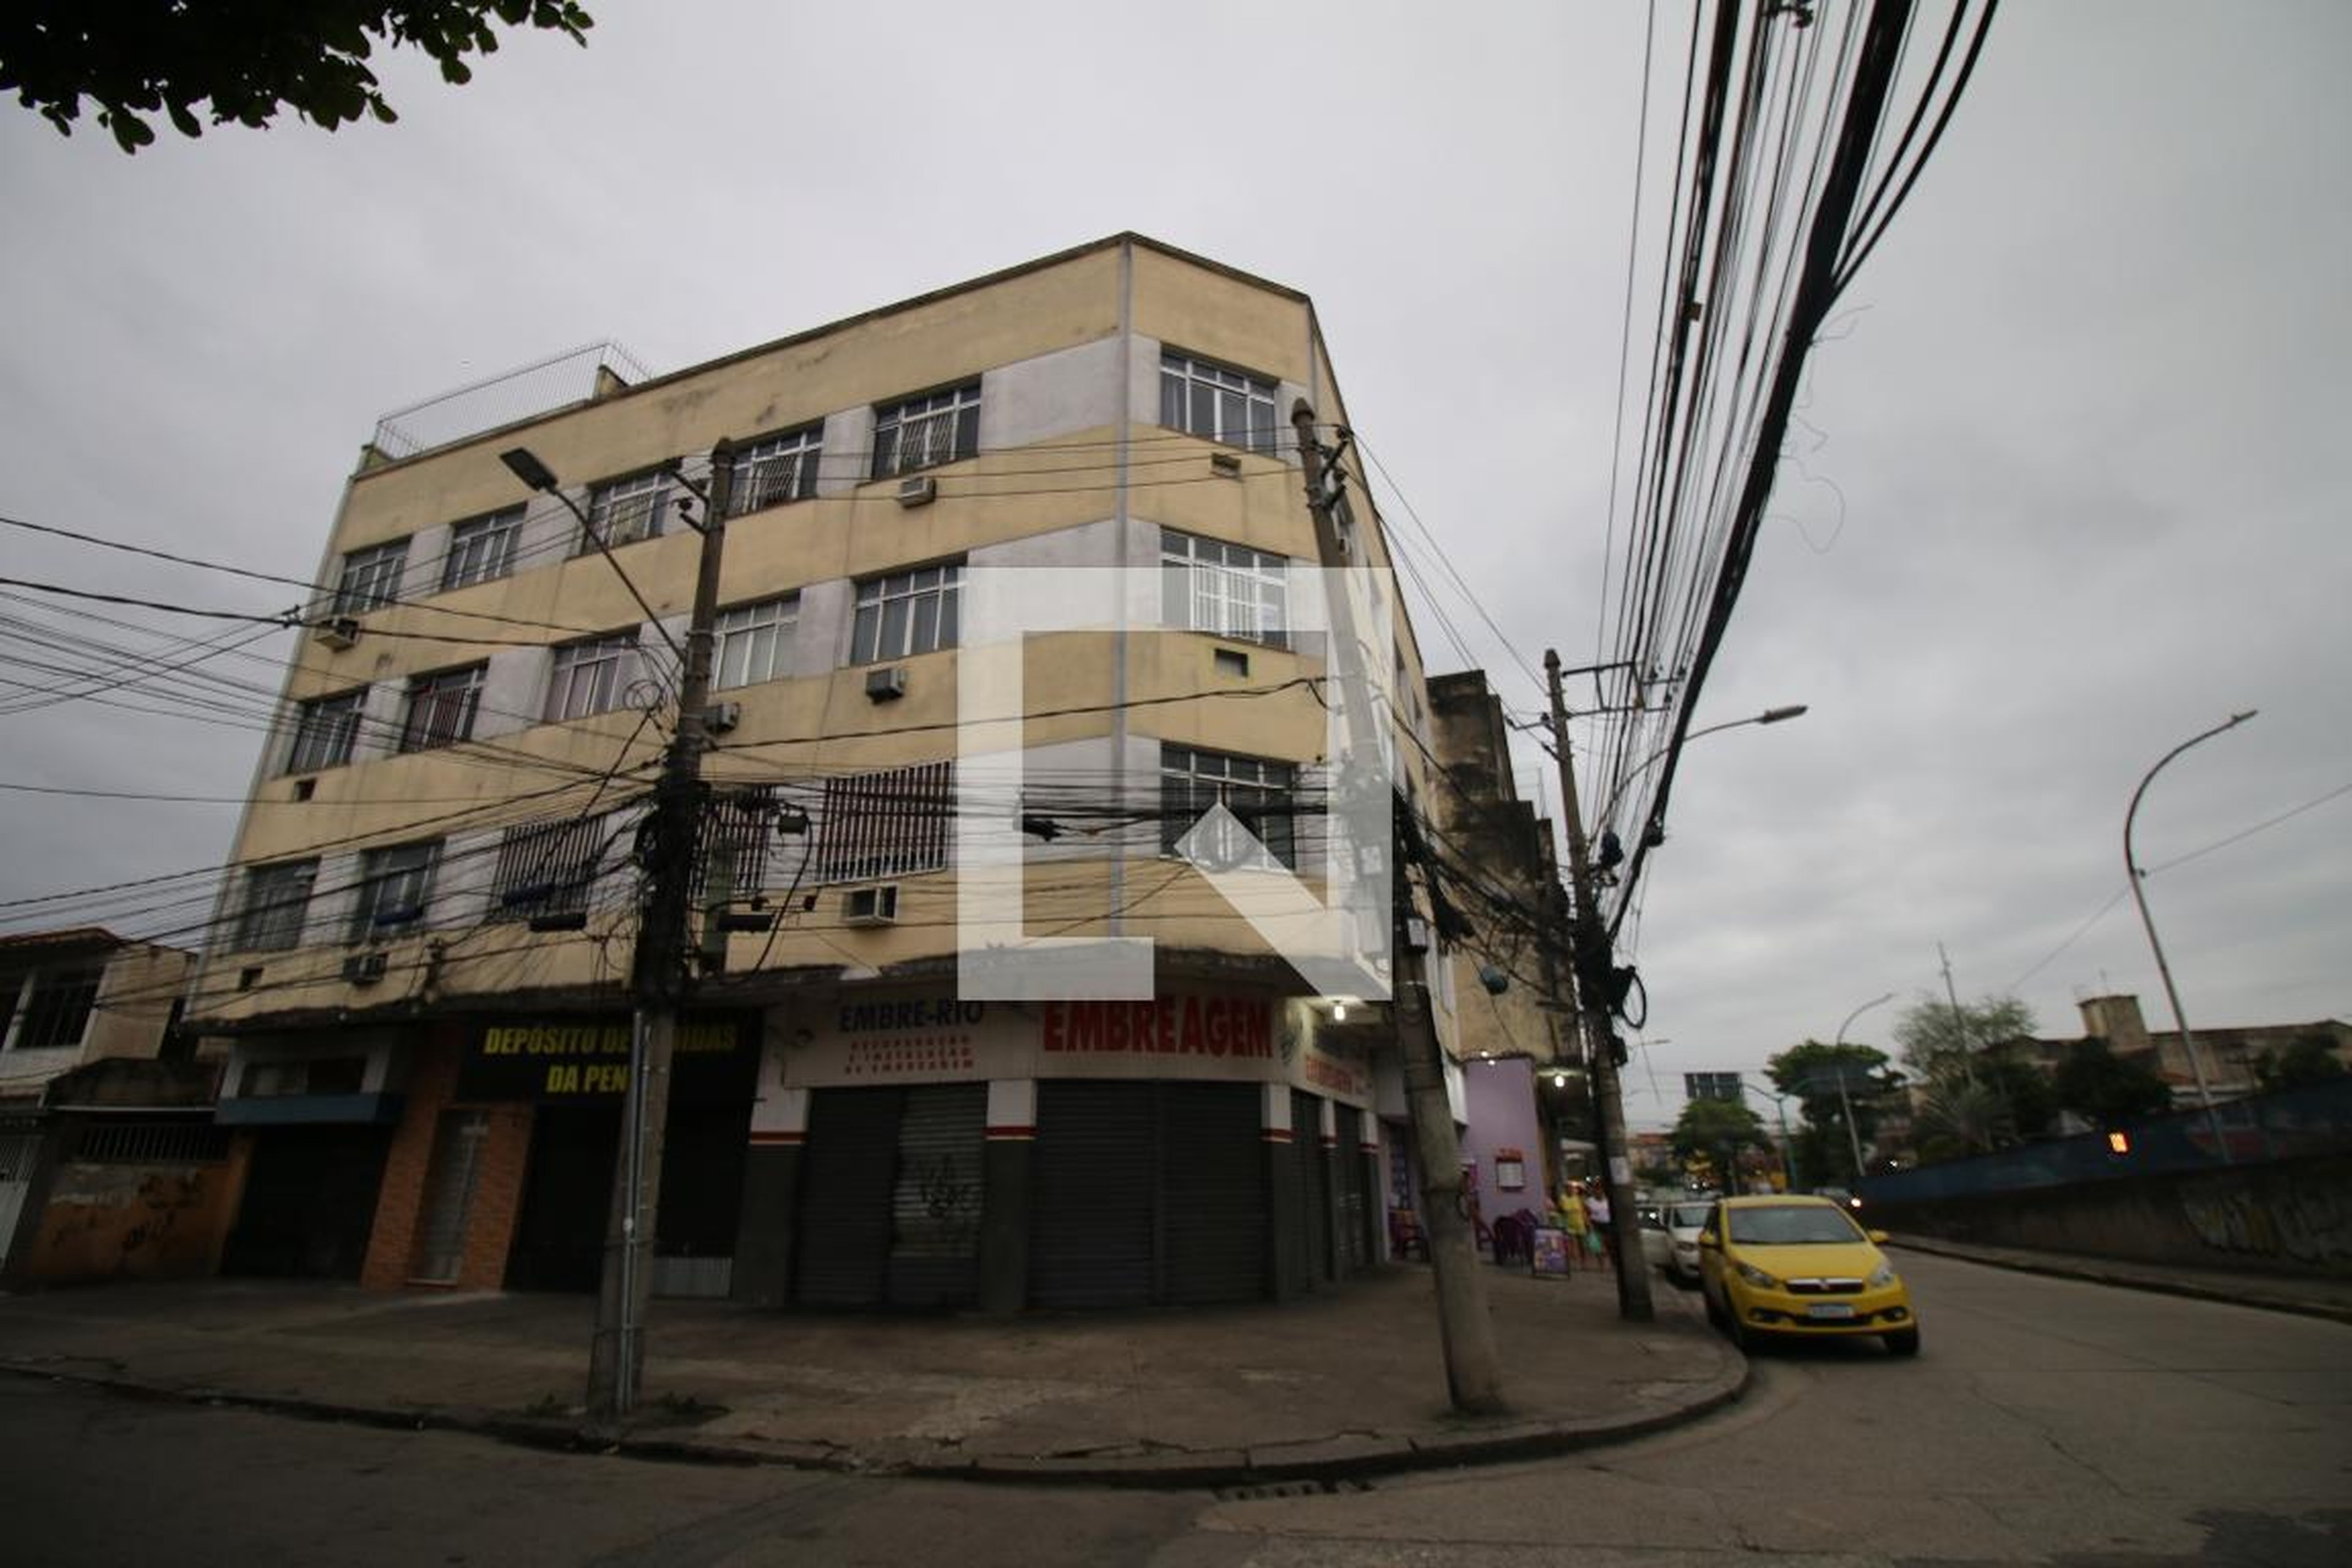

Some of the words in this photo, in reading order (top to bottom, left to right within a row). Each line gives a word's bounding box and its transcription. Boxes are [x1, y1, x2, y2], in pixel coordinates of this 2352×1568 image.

[838, 999, 981, 1032] EMBRE-RIO
[1045, 995, 1273, 1058] EMBREAGEM
[545, 1063, 578, 1093] DA
